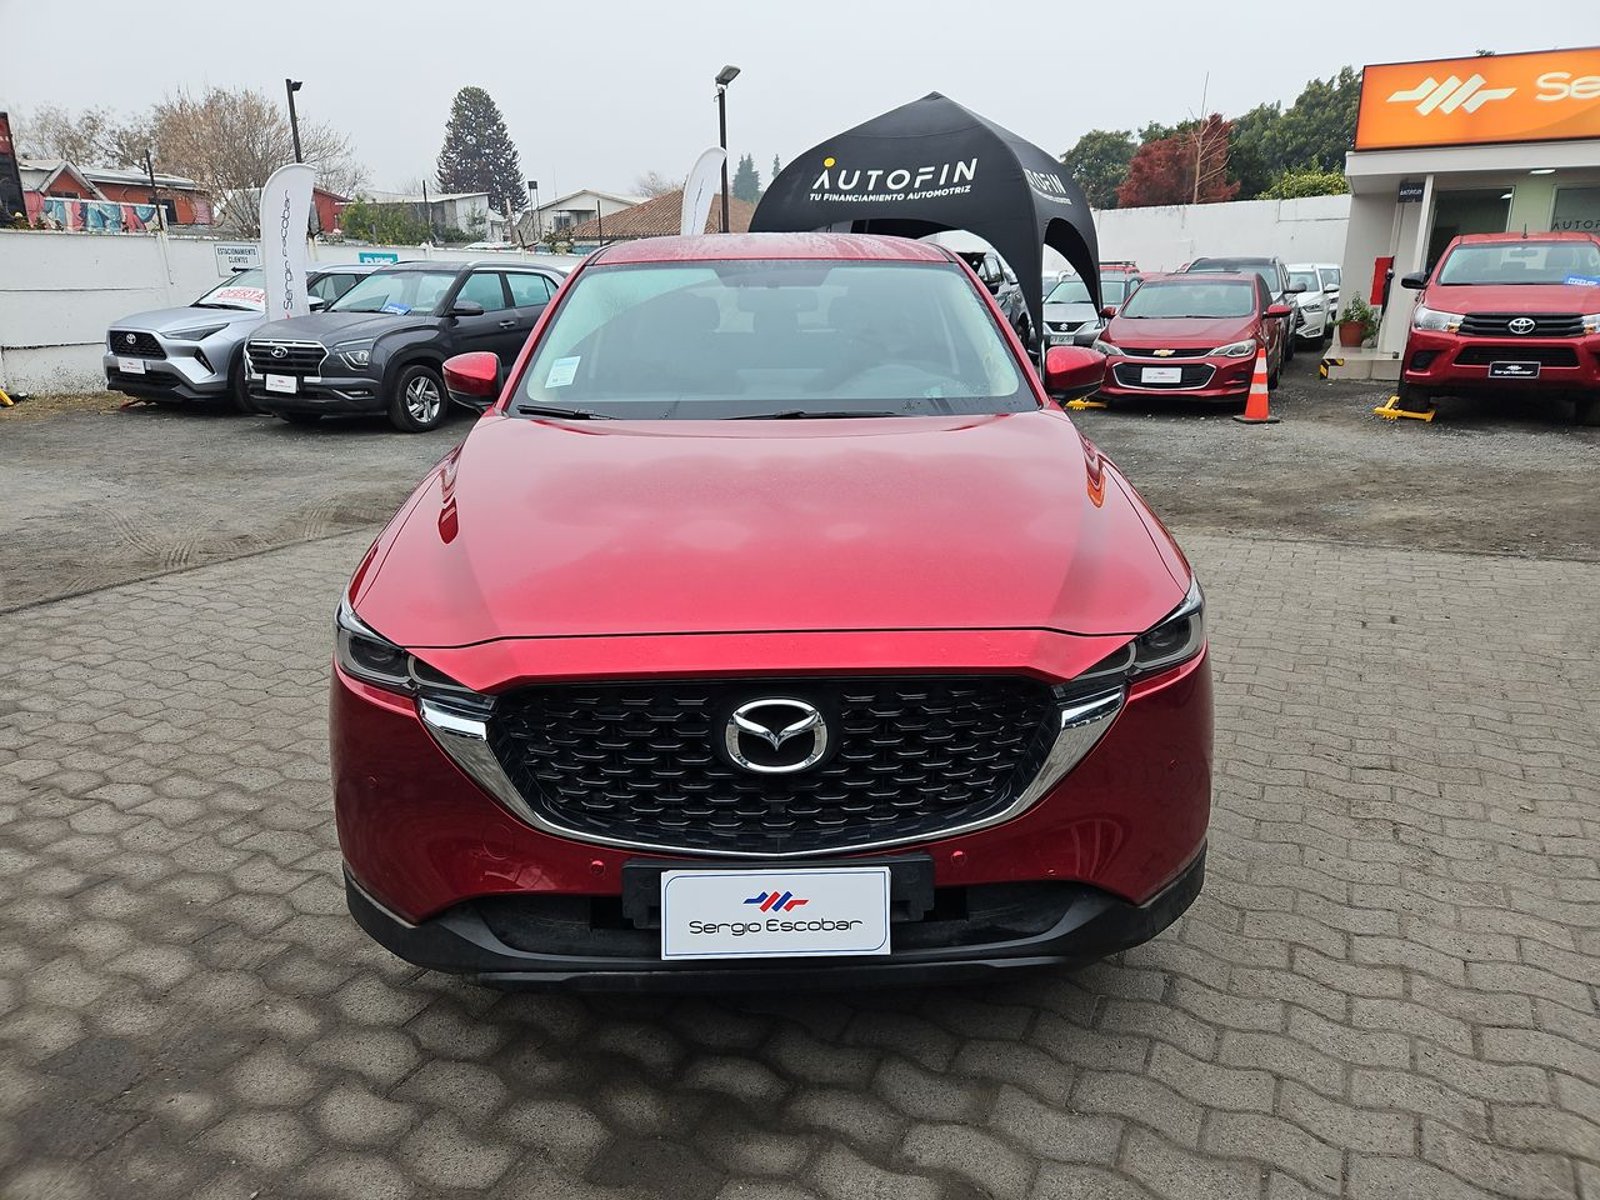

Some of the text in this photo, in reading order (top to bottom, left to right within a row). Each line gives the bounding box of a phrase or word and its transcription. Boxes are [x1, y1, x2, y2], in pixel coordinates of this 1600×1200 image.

[812, 157, 978, 191] AUTOFIN
[809, 184, 972, 202] TU FINANCIAMIENTO AUTOMOTRIZ
[217, 247, 257, 256] ESTACIONAMIENTO
[228, 255, 249, 264] CLIENTES
[689, 918, 863, 936] Sergio Escobar
